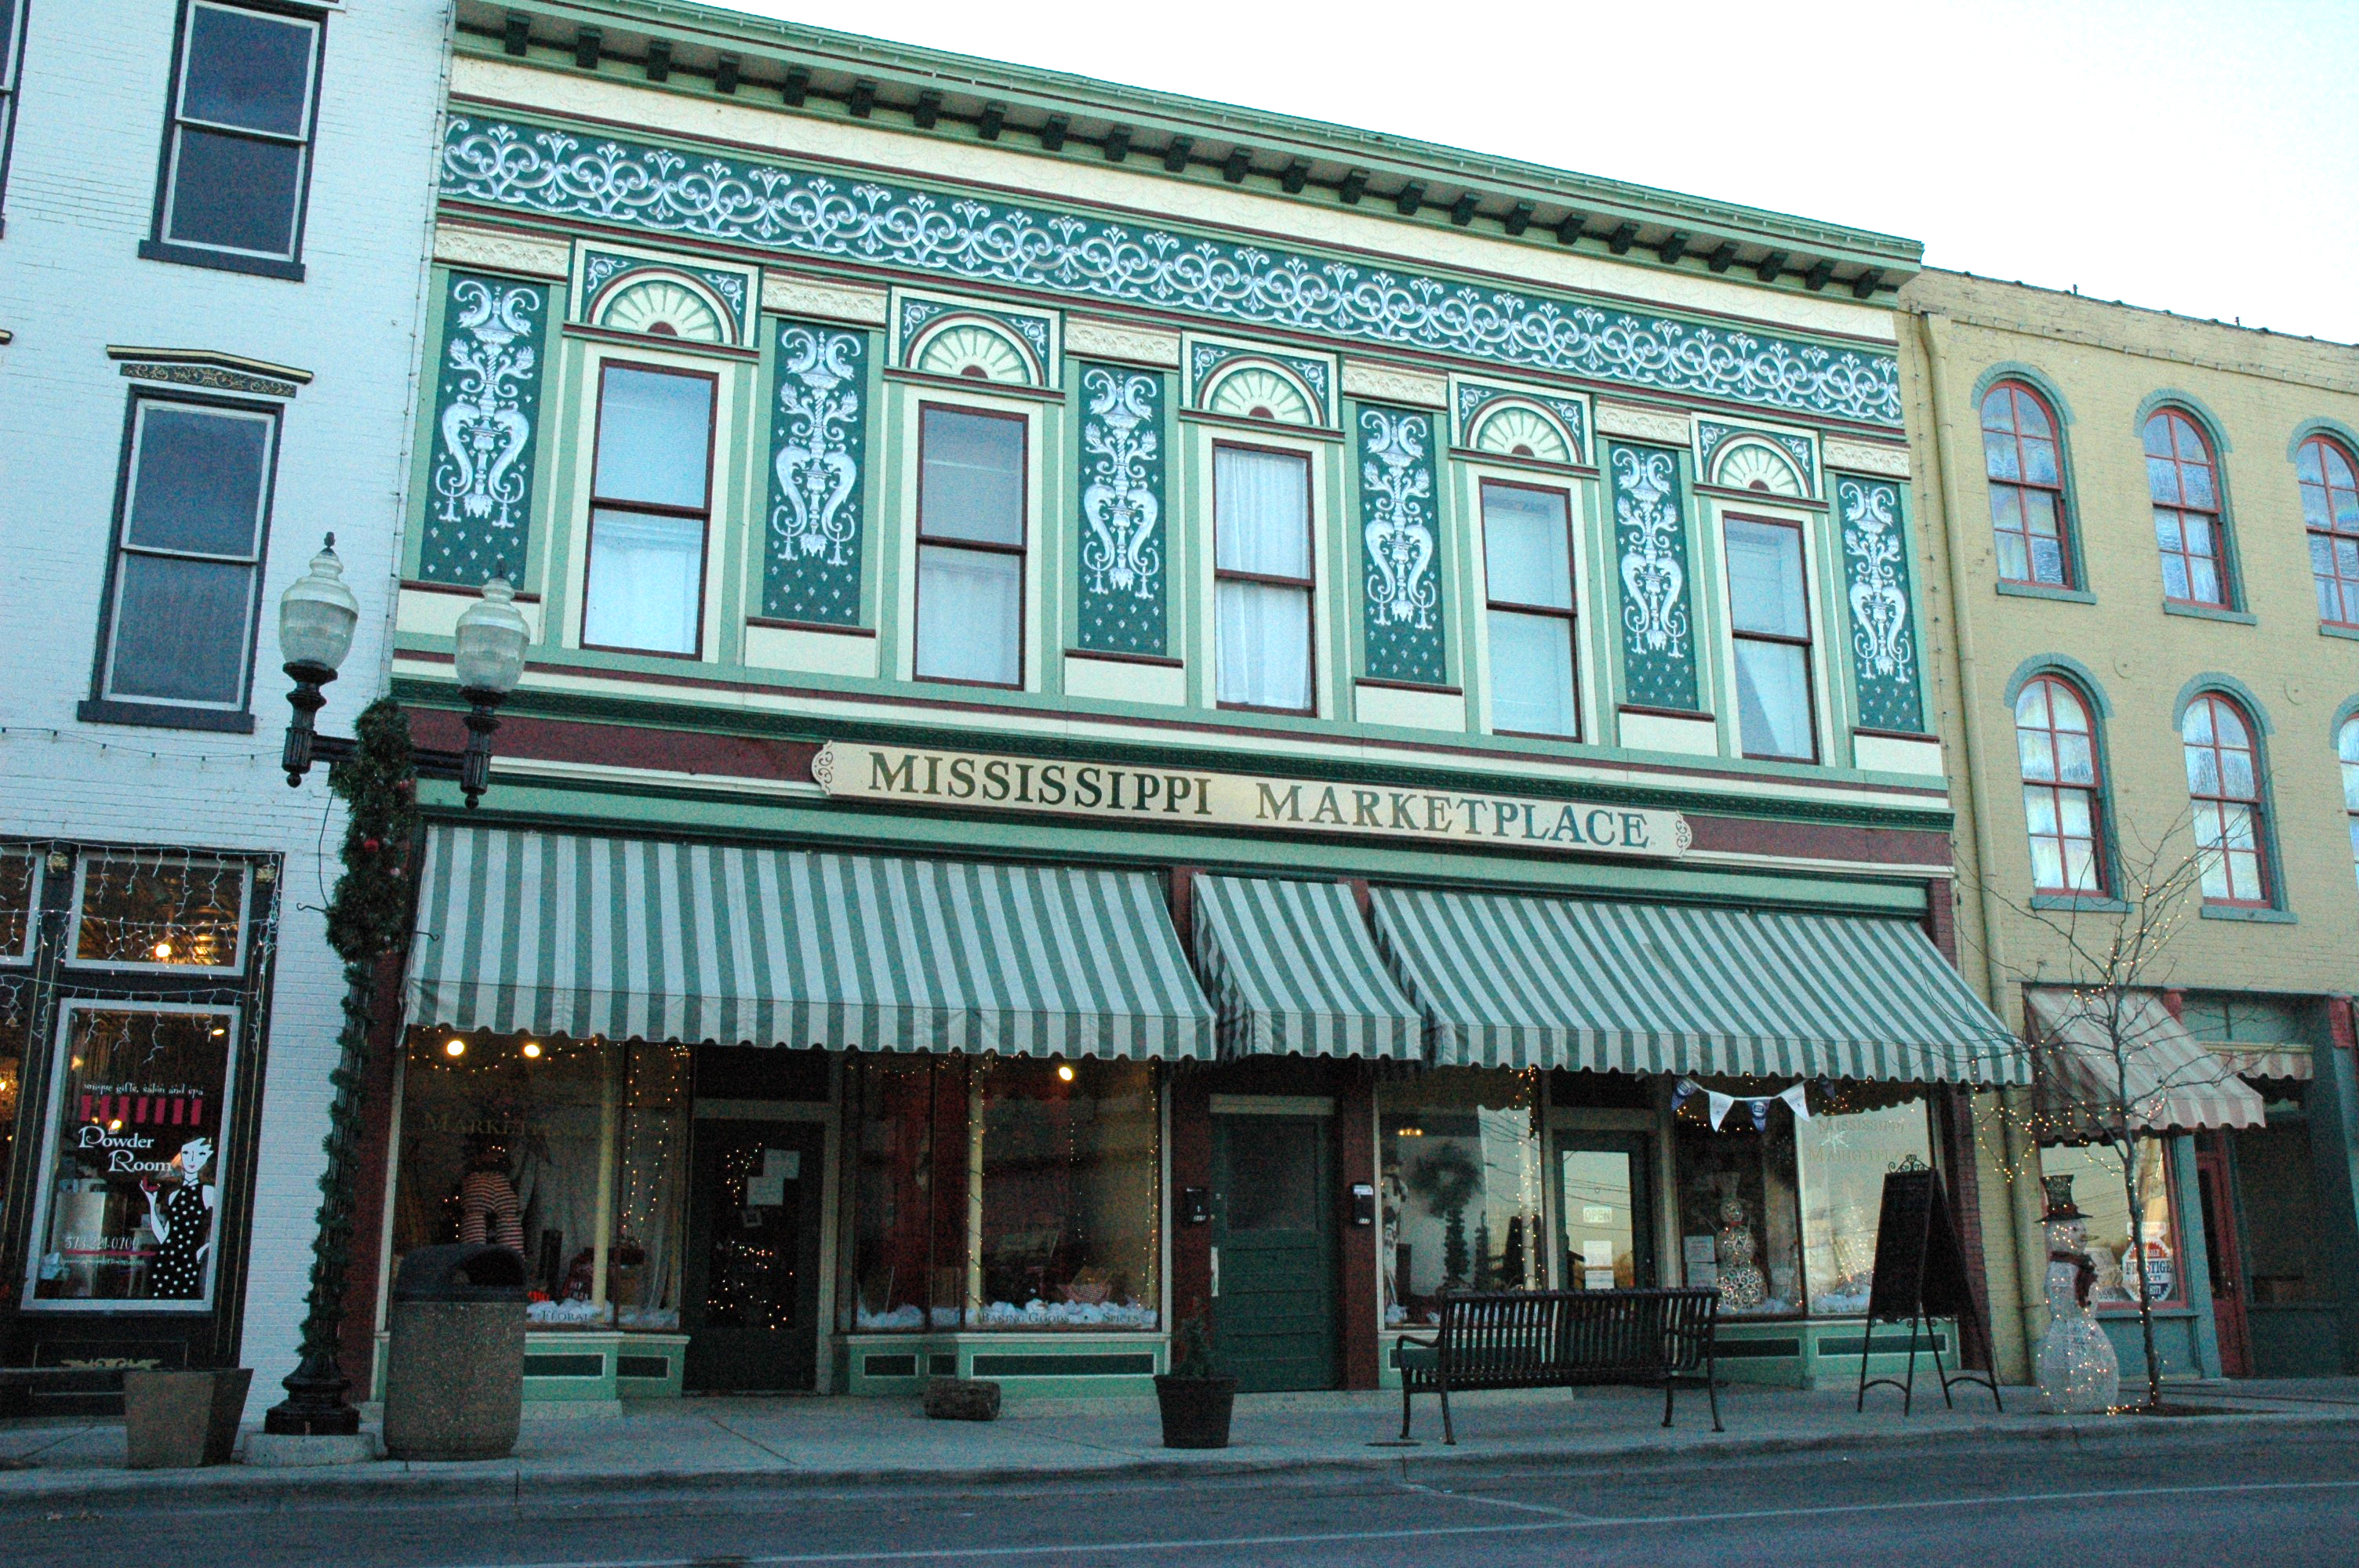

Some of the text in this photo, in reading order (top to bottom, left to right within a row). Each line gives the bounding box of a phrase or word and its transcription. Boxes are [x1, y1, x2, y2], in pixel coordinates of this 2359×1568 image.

[868, 751, 1651, 849] MISSISSIPPI MARKETPLACE
[169, 1083, 186, 1094] and
[187, 1086, 203, 1099] spa
[78, 1125, 155, 1149] Powder
[107, 1149, 173, 1173] Room
[1584, 1208, 1612, 1221] OPEN
[981, 1312, 1140, 1323] BAKING GOODS SPICES
